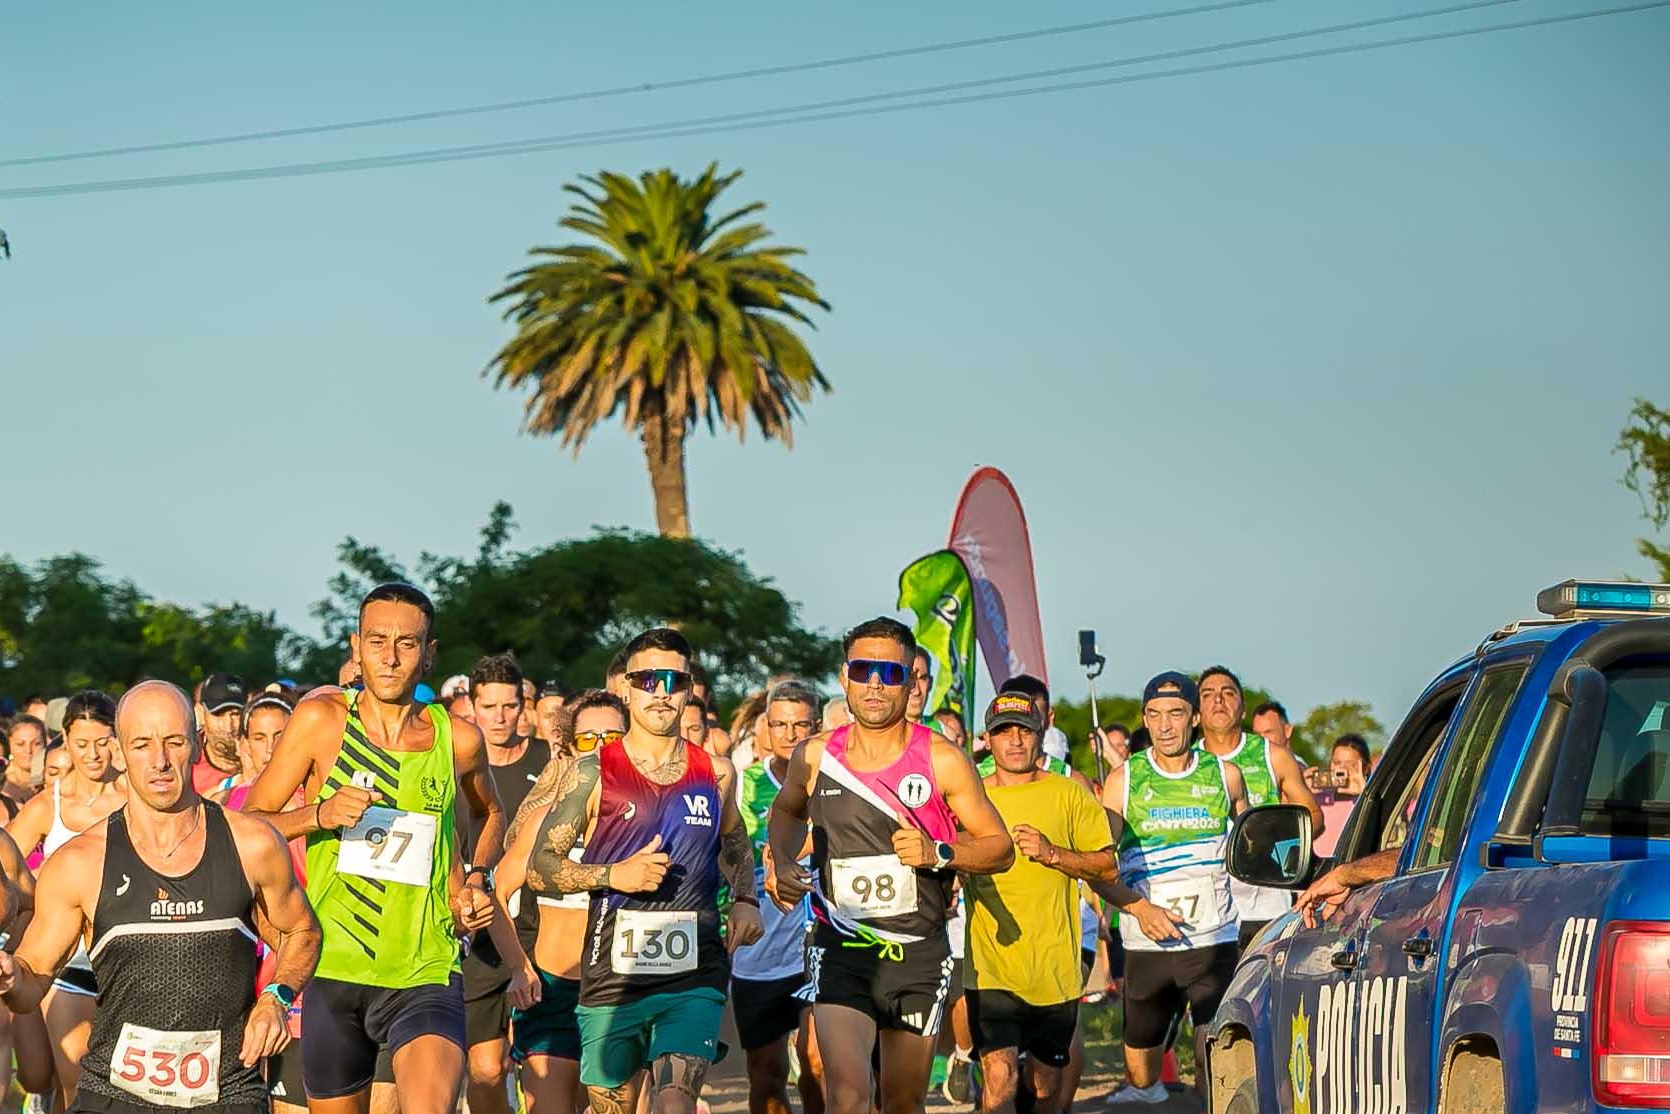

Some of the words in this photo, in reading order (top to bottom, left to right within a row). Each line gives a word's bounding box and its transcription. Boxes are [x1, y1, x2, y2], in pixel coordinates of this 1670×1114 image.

[683, 794, 710, 817] VR
[1150, 807, 1210, 820] FIGHIERA
[684, 816, 712, 827] TEAM
[365, 827, 413, 863] 97
[851, 874, 896, 904] 98
[150, 899, 204, 915] ATENAS
[620, 928, 690, 960] 130
[1551, 916, 1598, 1012] 911
[119, 1046, 210, 1089] 530
